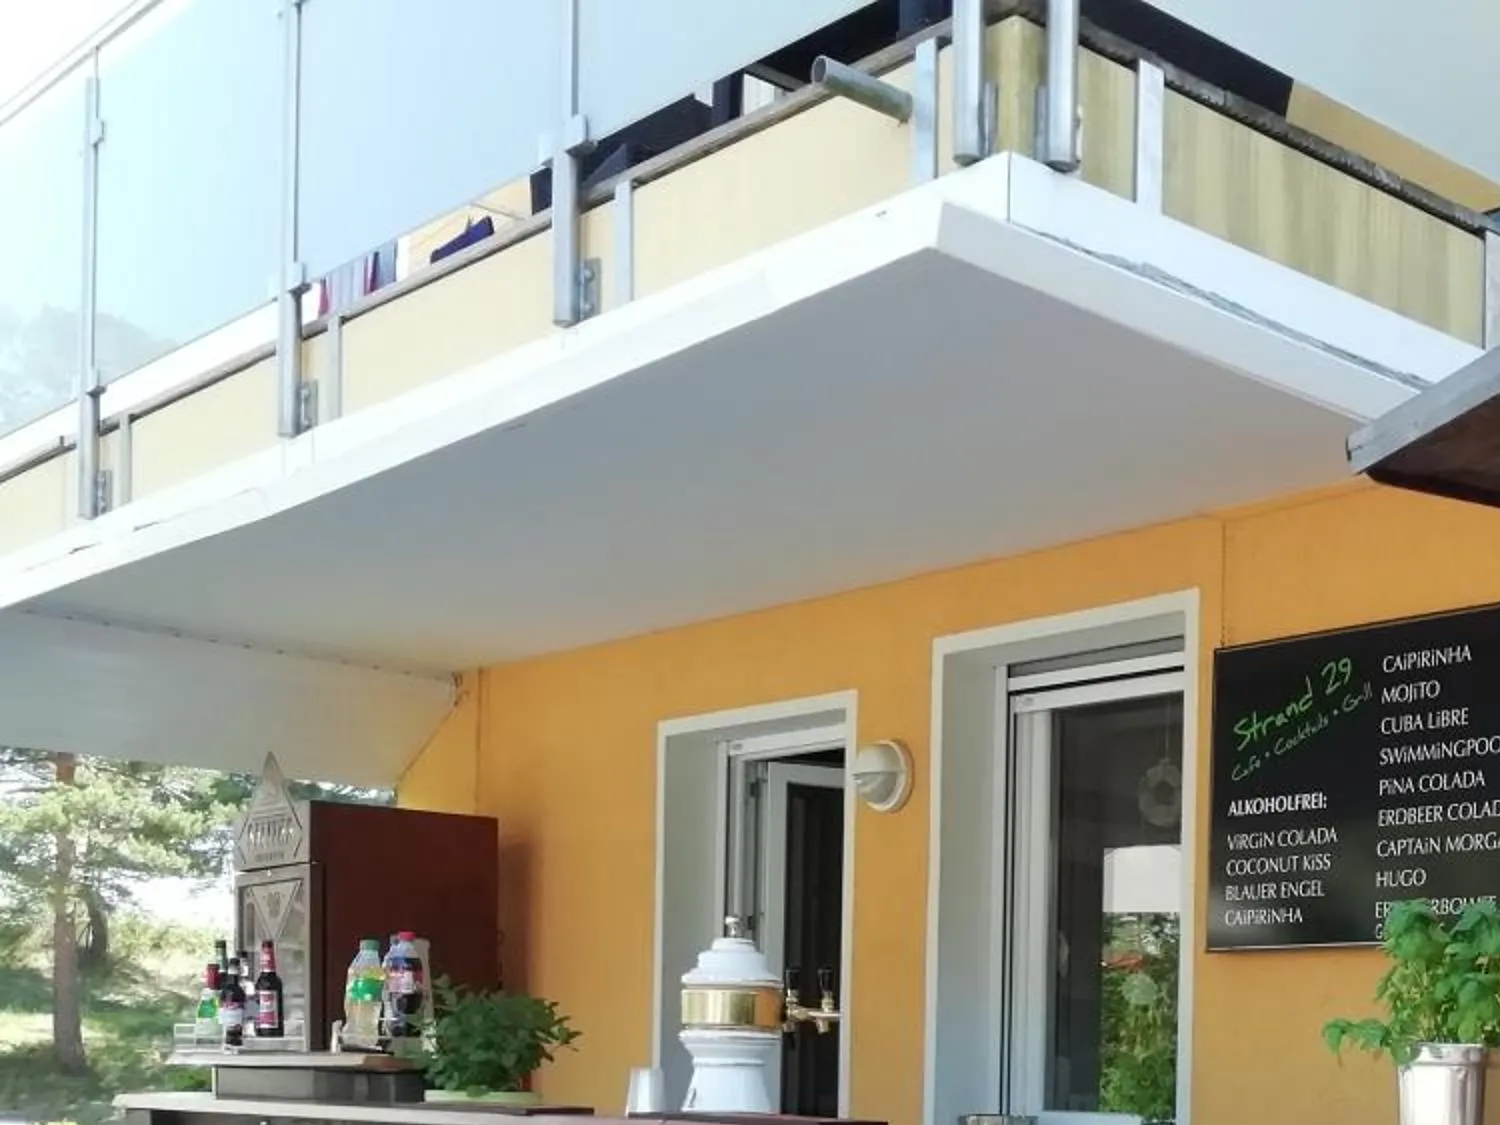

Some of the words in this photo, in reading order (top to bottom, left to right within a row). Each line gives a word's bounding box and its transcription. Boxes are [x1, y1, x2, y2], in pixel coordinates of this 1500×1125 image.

[1233, 675, 1313, 751] Strand
[1321, 657, 1352, 696] 29
[1381, 713, 1424, 734] CUBA
[1419, 769, 1486, 792] COLADA
[1378, 805, 1443, 827] ERDBEER
[1277, 826, 1339, 847] COLADA
[1226, 855, 1299, 876] COCONUT
[1375, 867, 1427, 888] HUGO
[1225, 883, 1277, 901] BLAUER
[1281, 879, 1326, 899] ENGEL
